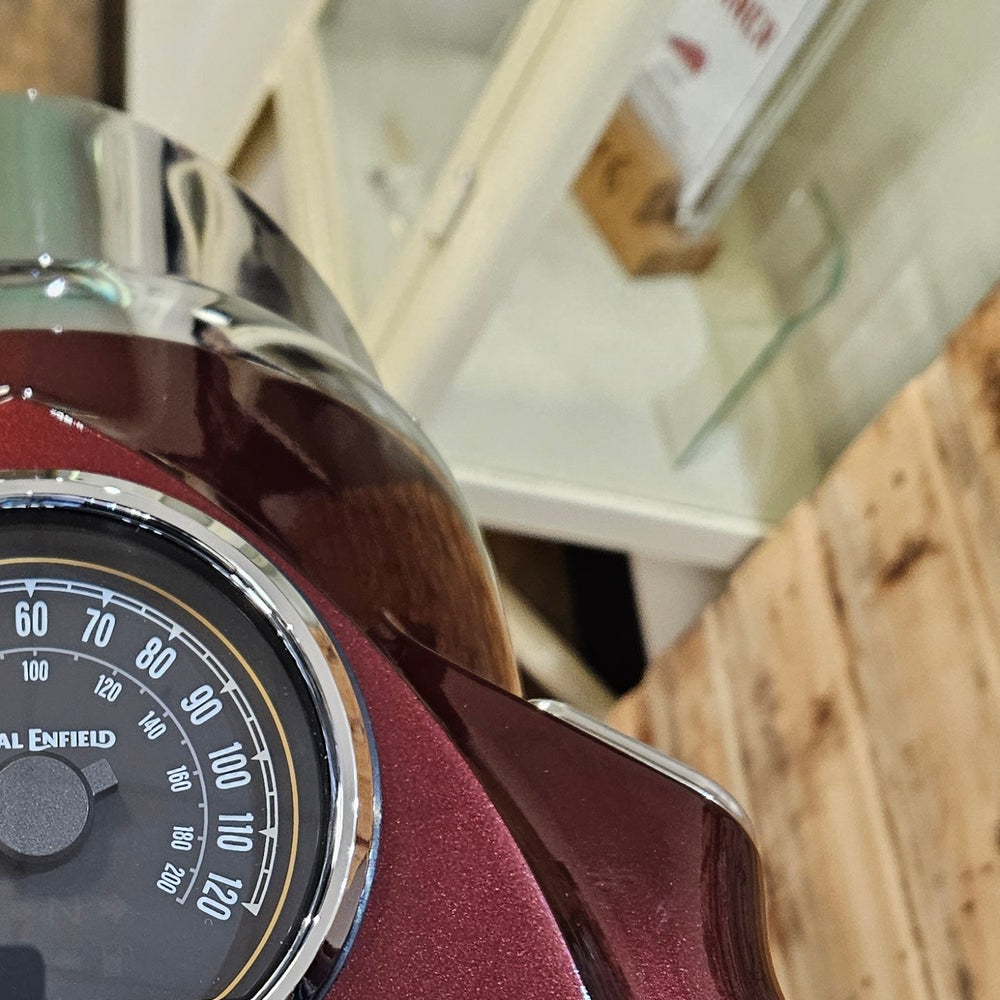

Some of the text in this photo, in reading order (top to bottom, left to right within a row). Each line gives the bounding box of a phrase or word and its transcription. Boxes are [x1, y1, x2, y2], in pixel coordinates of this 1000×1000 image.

[15, 600, 48, 637] 60
[81, 608, 116, 647] 70
[22, 659, 48, 681] 100
[135, 636, 177, 679] 80
[93, 674, 123, 702] 120
[180, 685, 223, 726] 90
[28, 728, 116, 751] ENFIELD
[138, 710, 168, 740] 140
[166, 764, 192, 793] 160
[208, 741, 252, 790] 100
[171, 824, 194, 851] 180
[217, 812, 254, 852] 110
[156, 861, 186, 895] 200
[197, 871, 244, 920] 120
